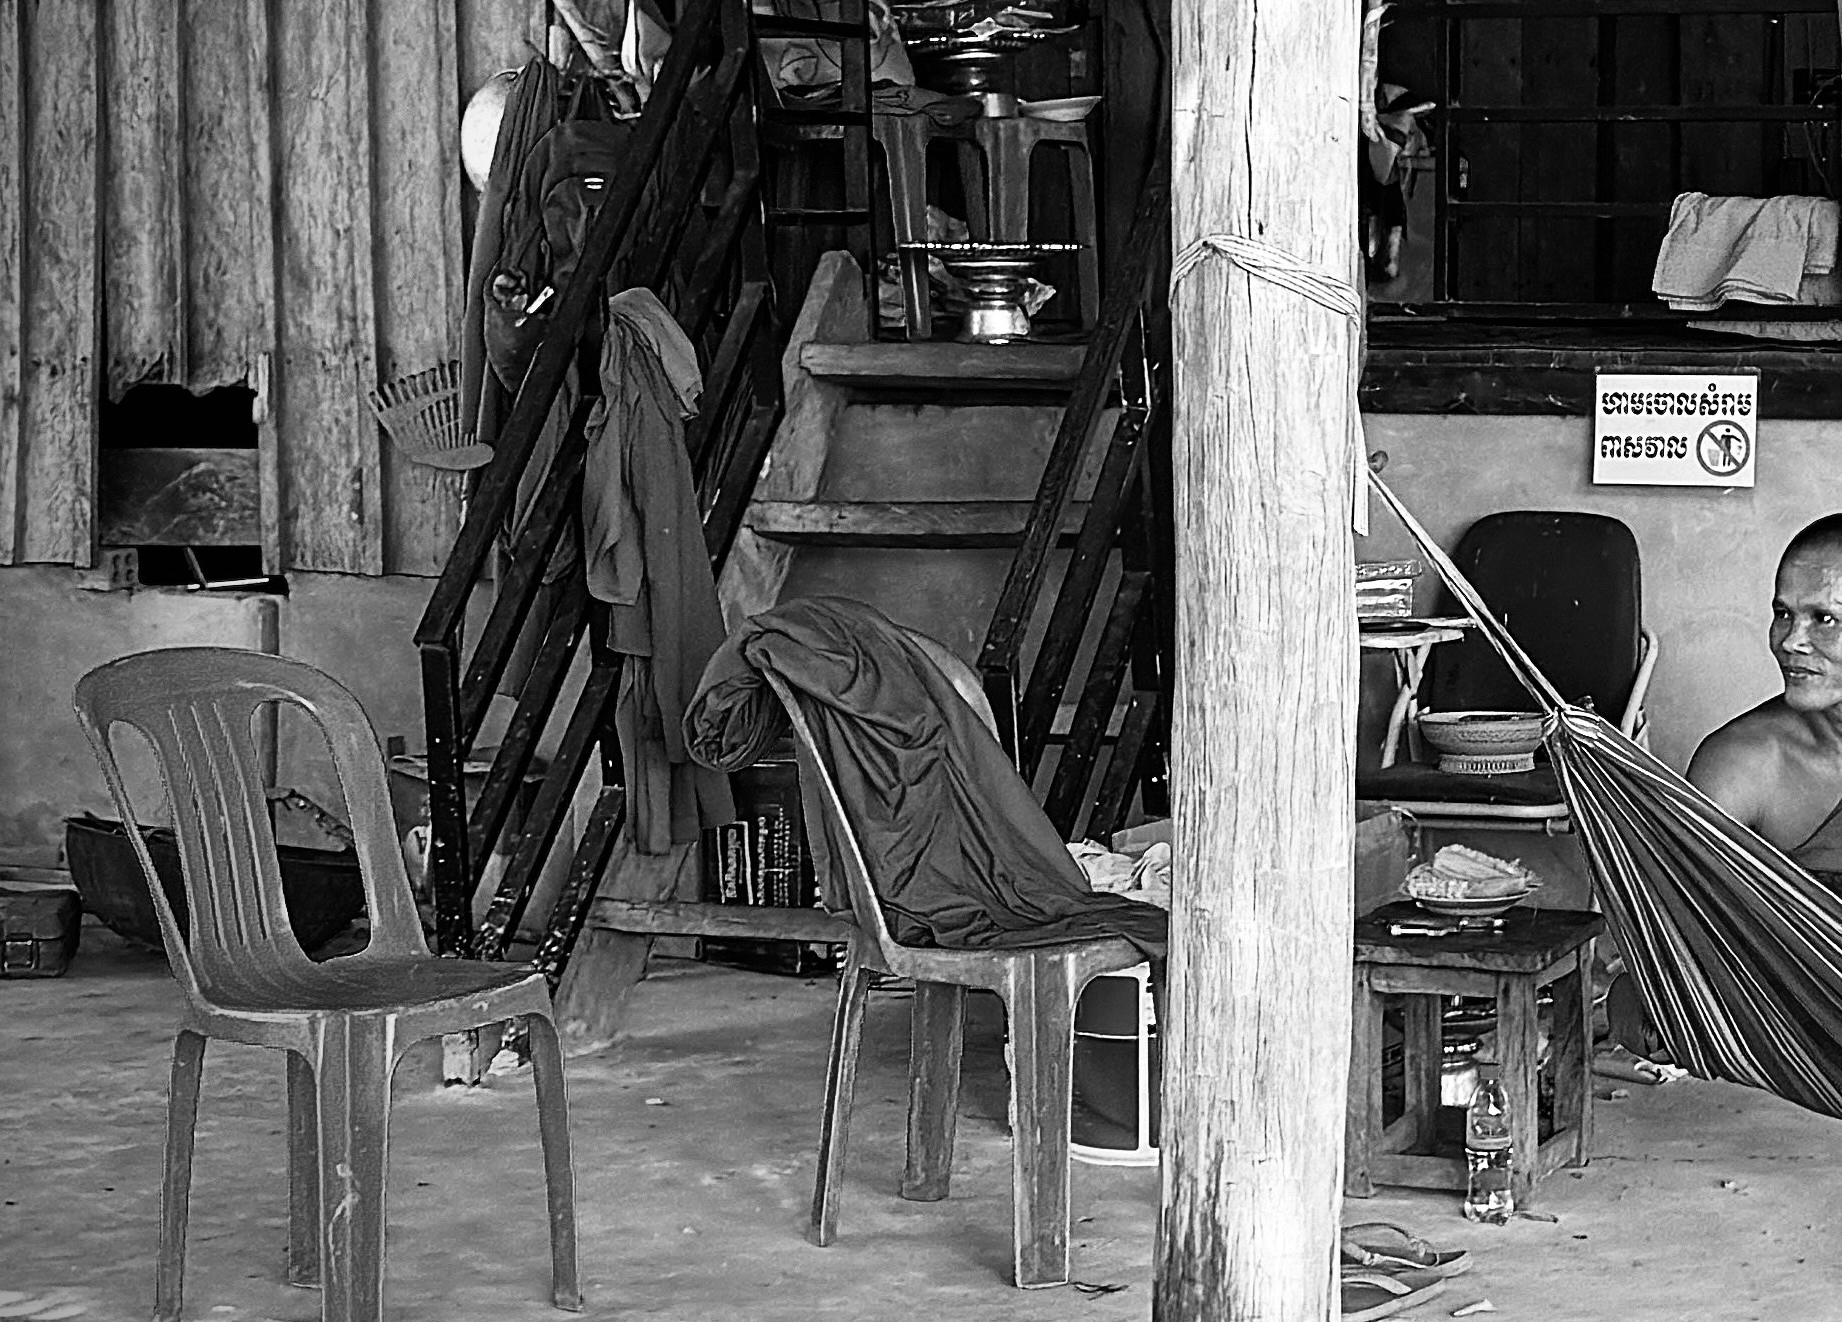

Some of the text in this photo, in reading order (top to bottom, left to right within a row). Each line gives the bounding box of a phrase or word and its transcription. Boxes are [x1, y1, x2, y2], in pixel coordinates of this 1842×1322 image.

[1601, 382, 1752, 416] ហាមចោលសំរាម
[1600, 434, 1688, 459] ពាសវាល
